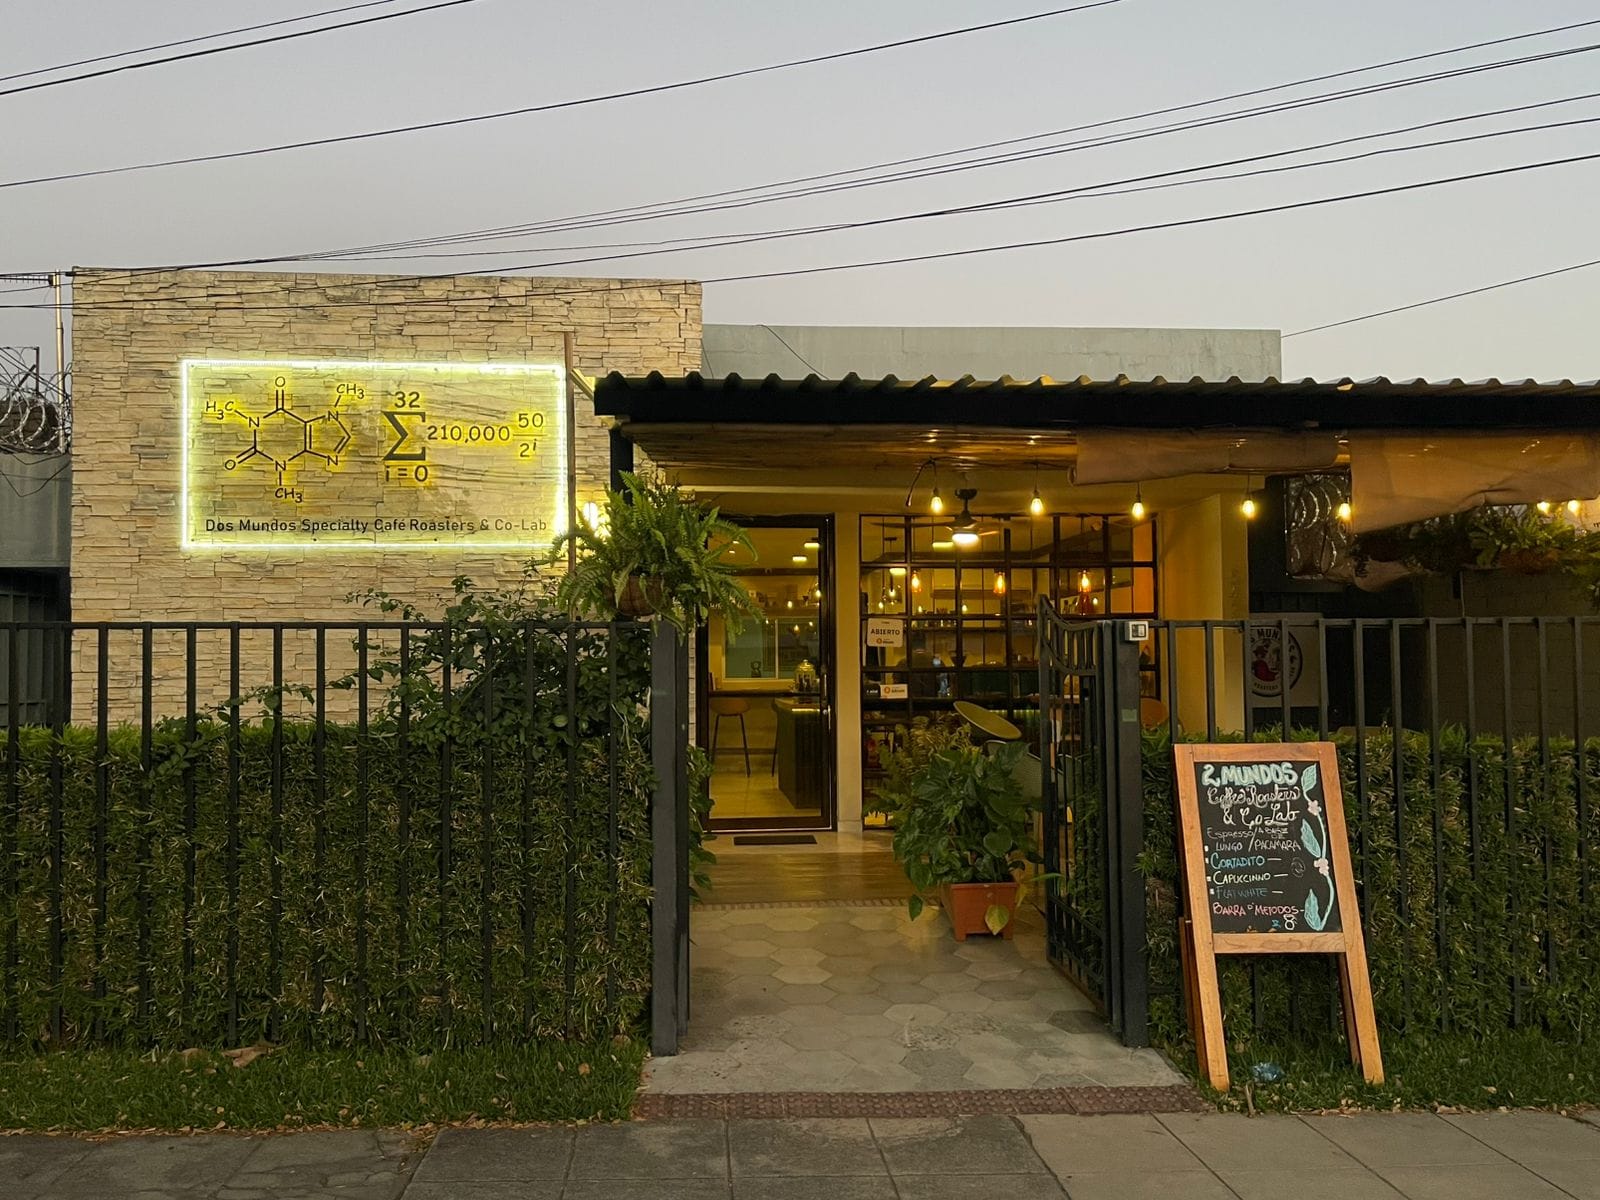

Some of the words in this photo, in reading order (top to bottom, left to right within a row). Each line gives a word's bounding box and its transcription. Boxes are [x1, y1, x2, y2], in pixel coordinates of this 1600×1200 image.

[394, 391, 421, 409] 32
[248, 416, 260, 428] N
[327, 410, 339, 422] N
[518, 412, 544, 429] 50
[427, 425, 510, 443] 210,000
[275, 460, 287, 471] N
[327, 455, 339, 466] N
[205, 518, 234, 532] Dos
[239, 518, 297, 532] Mundos
[301, 518, 369, 534] Specialty
[409, 518, 474, 531] Roasters
[479, 518, 490, 531] &
[494, 518, 547, 531] Co-Lab
[870, 628, 900, 636] ABIERTO
[1201, 763, 1221, 788] 2
[1221, 761, 1299, 787] MUNDOS
[1222, 806, 1237, 826] &
[1239, 800, 1300, 829] Co-Lab
[1215, 841, 1243, 853] LUNGO
[1254, 839, 1301, 852] PACAMARA
[1210, 852, 1265, 870] CORTADITO
[1212, 901, 1247, 917] BARRA
